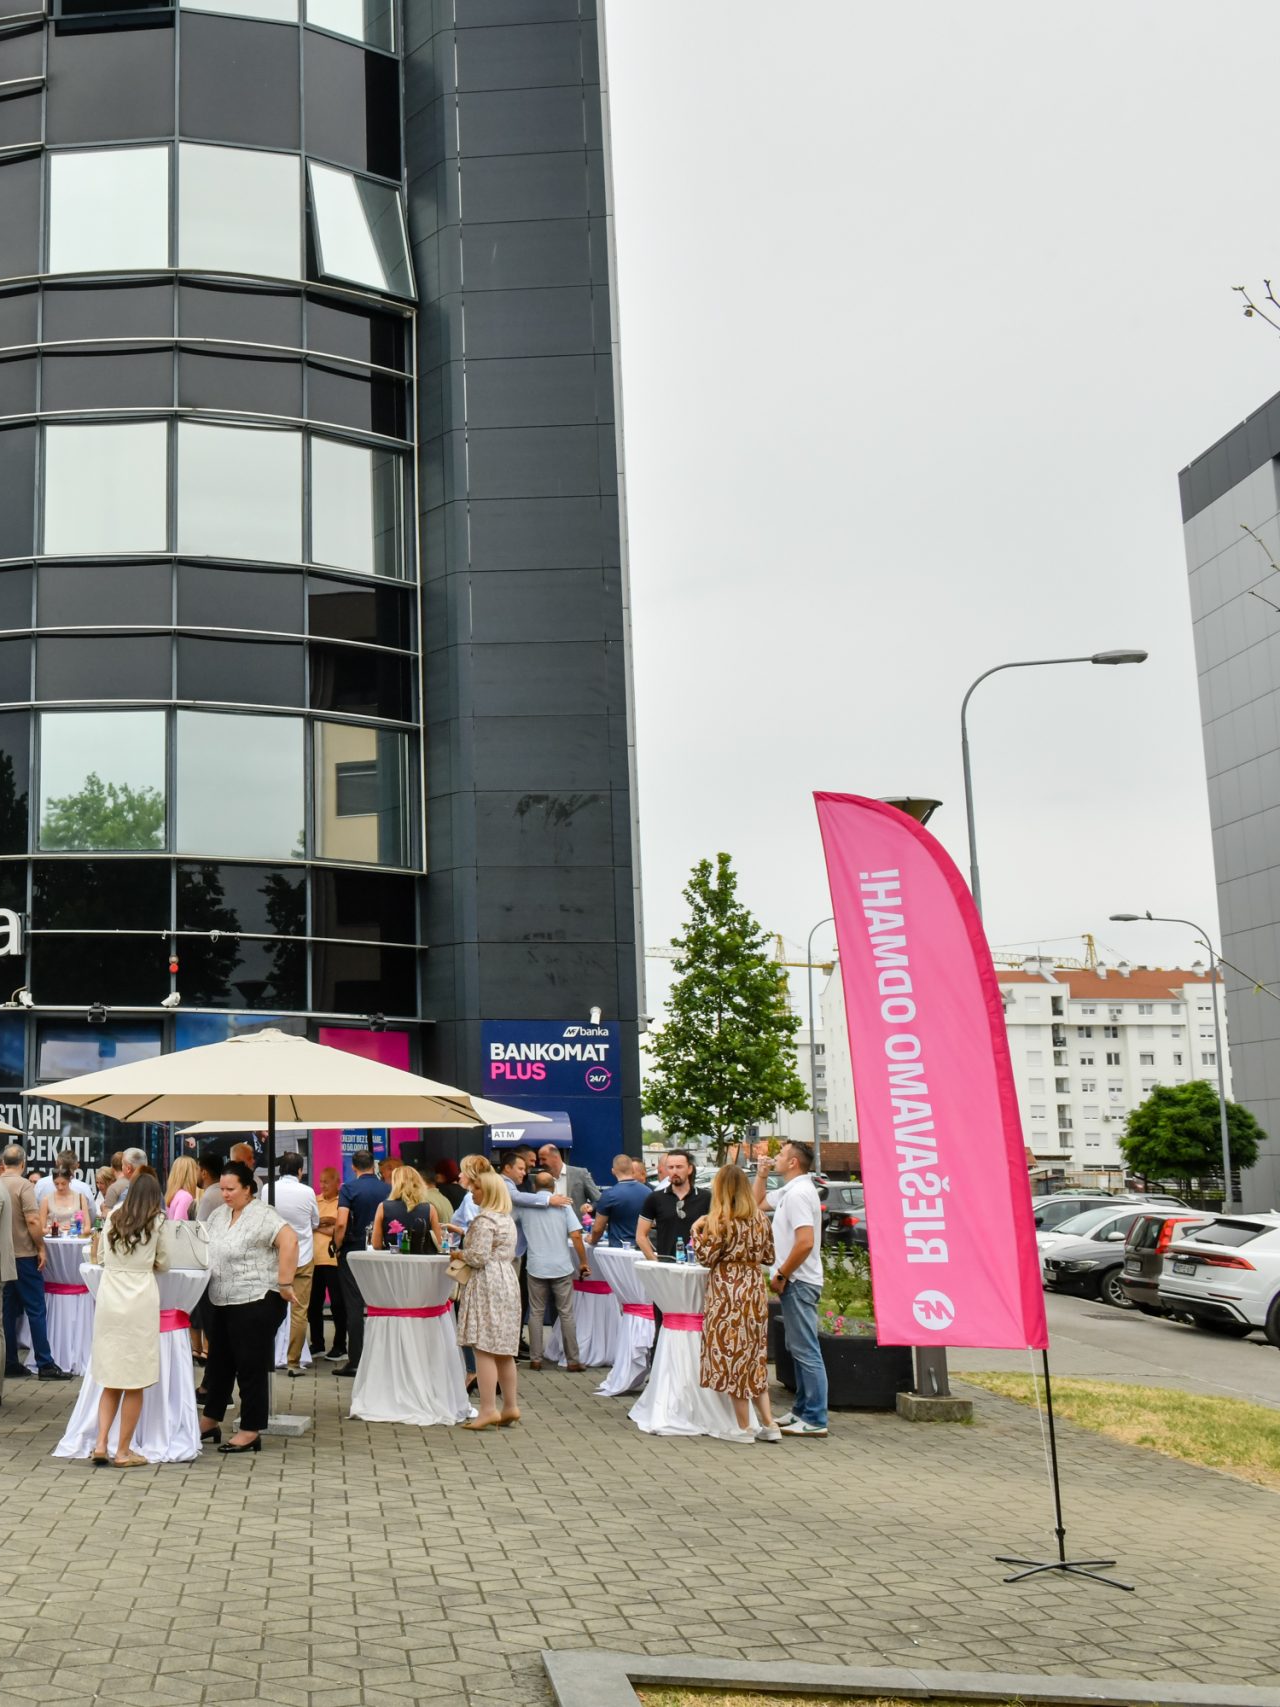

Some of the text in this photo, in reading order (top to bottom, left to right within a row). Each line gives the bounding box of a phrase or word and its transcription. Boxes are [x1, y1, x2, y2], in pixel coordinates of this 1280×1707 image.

[580, 1027, 609, 1037] banka
[490, 1043, 609, 1061] BANKOMAT
[491, 1062, 546, 1080] PLUS
[589, 1075, 607, 1083] 24/7
